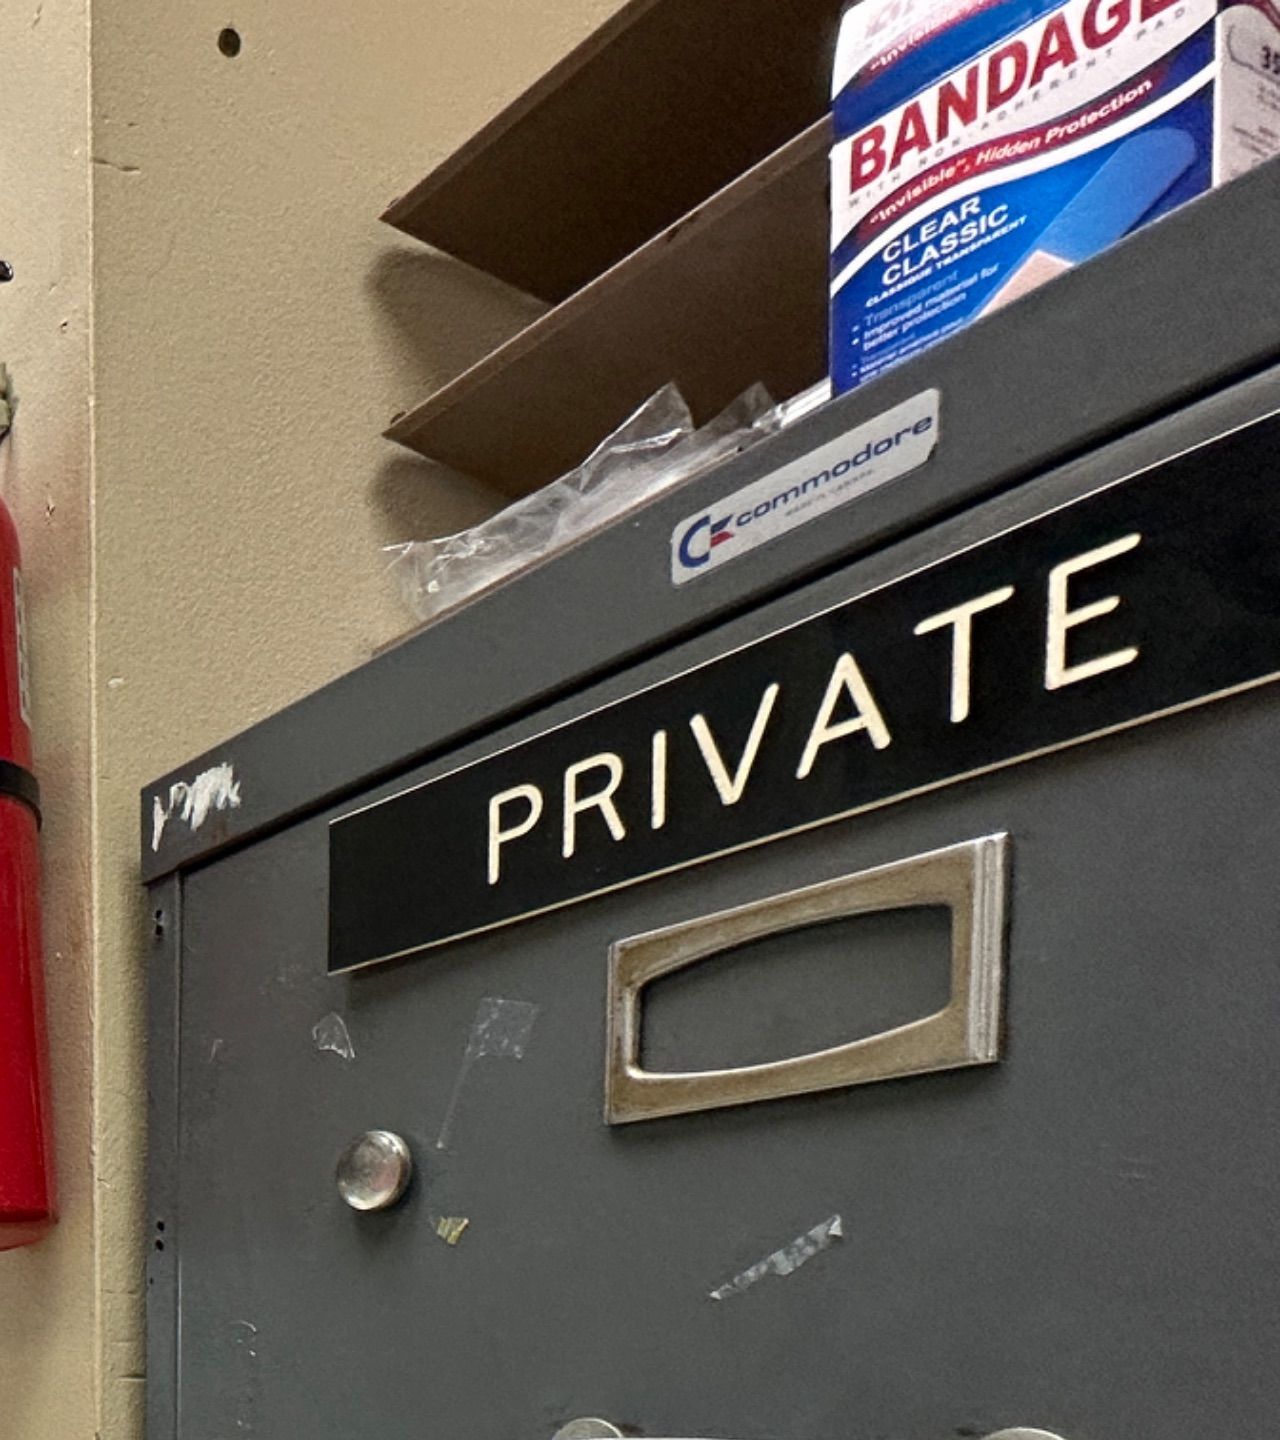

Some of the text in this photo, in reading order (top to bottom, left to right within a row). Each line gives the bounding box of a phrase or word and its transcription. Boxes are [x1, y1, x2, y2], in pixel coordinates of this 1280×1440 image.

[975, 136, 1042, 166] Hidden
[1044, 78, 1153, 144] Protection
[881, 196, 982, 263] CLEAR
[881, 204, 1009, 286] CLASSIC
[735, 415, 933, 527] commodore
[487, 532, 1142, 885] PRIVATE
